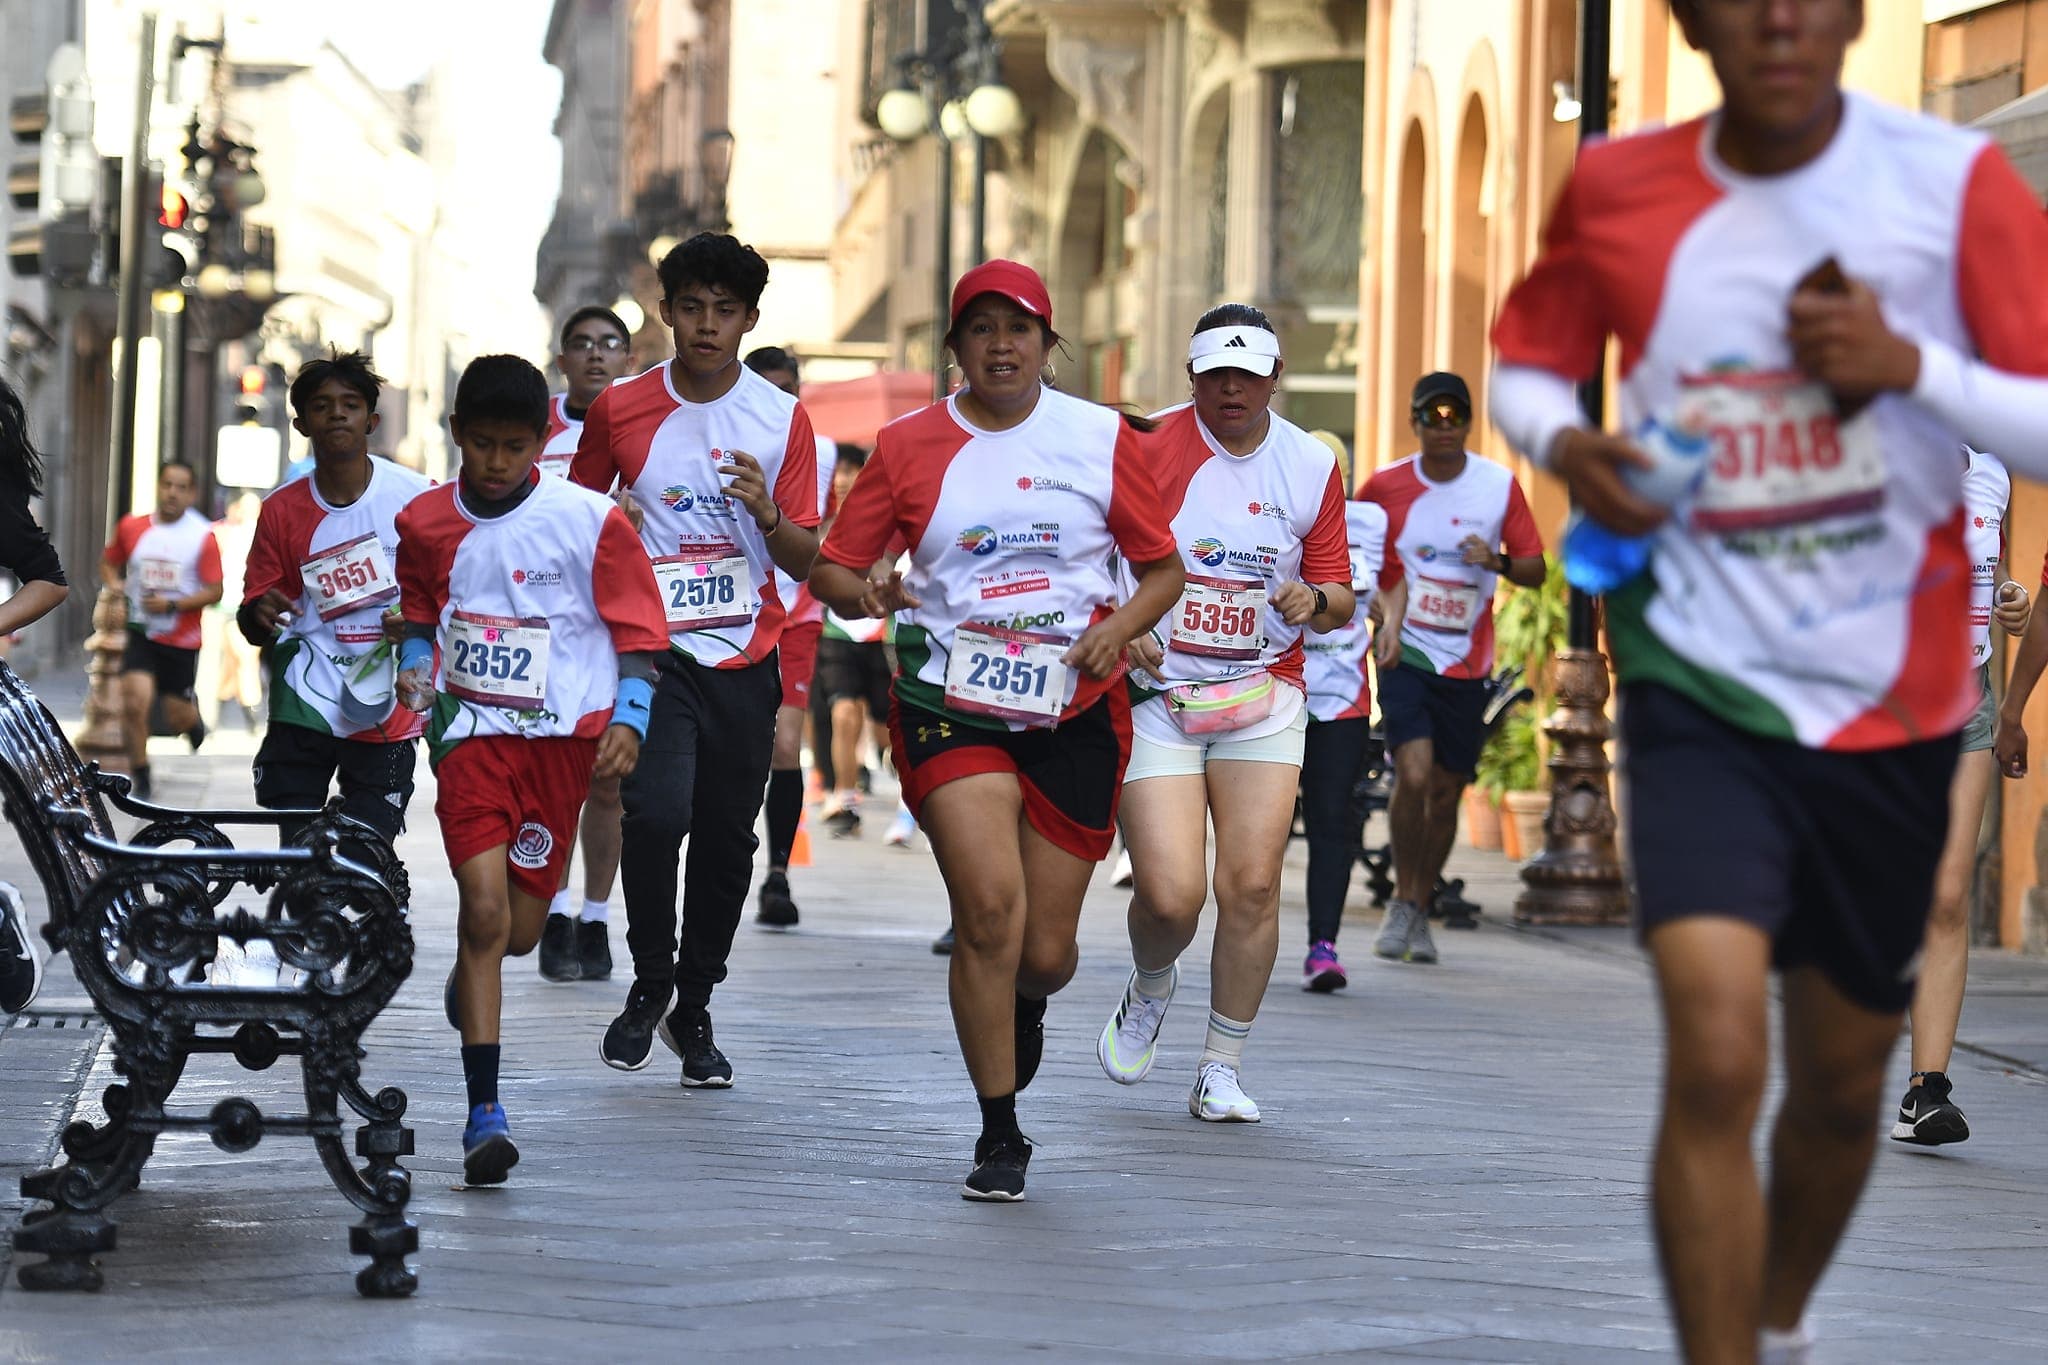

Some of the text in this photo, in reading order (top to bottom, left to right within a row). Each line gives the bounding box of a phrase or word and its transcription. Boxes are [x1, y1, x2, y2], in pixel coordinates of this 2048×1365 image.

[1711, 415, 1843, 481] 3748
[1032, 523, 1059, 531] MEDIO
[335, 553, 348, 565] 5K
[1256, 545, 1279, 555] MEDIO
[317, 557, 378, 598] 3651
[670, 574, 735, 609] 2578
[1220, 593, 1234, 604] 5K
[1183, 600, 1256, 636] 5358
[487, 630, 505, 643] 5K
[454, 639, 532, 681] 2352
[966, 652, 1048, 698] 2351
